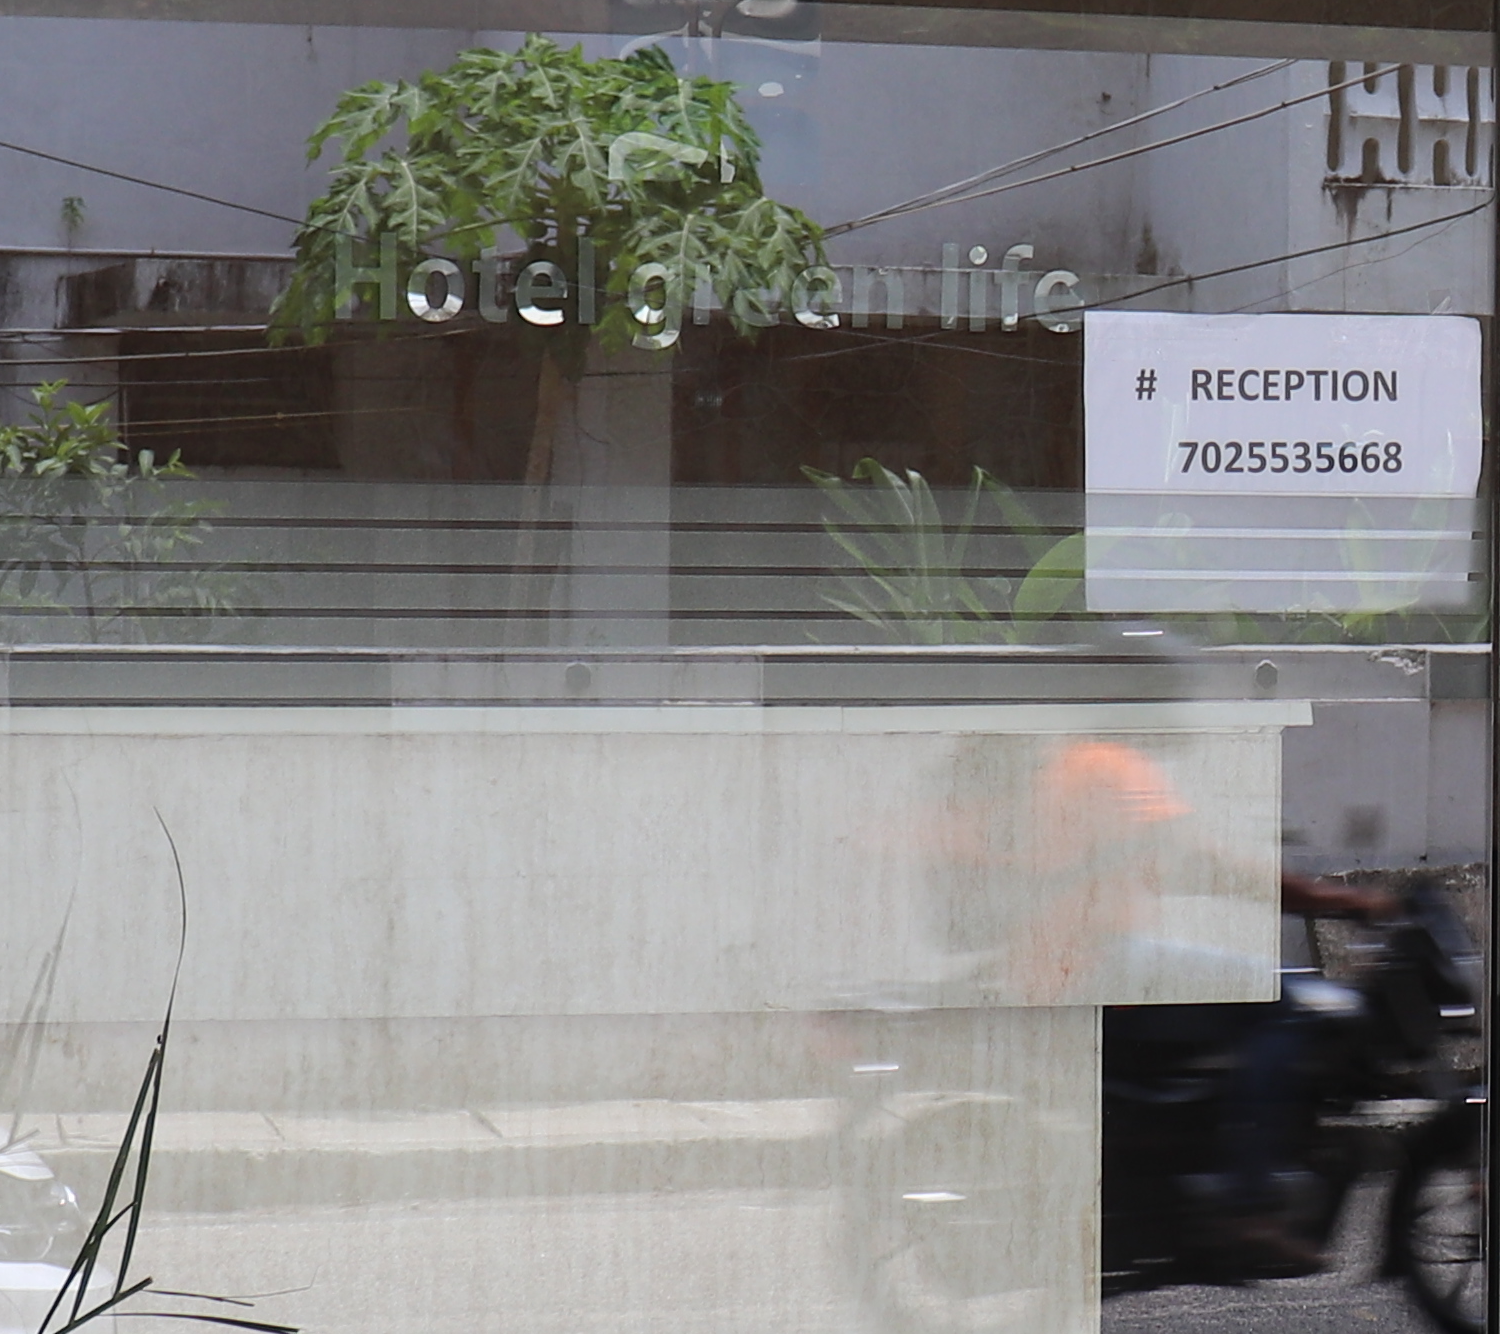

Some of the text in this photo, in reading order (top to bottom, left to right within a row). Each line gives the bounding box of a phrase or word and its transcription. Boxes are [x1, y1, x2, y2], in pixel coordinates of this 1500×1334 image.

[334, 231, 1086, 350] Hotel green life
[1190, 368, 1399, 402] RECEPTION
[1177, 440, 1403, 474] 7025535668
